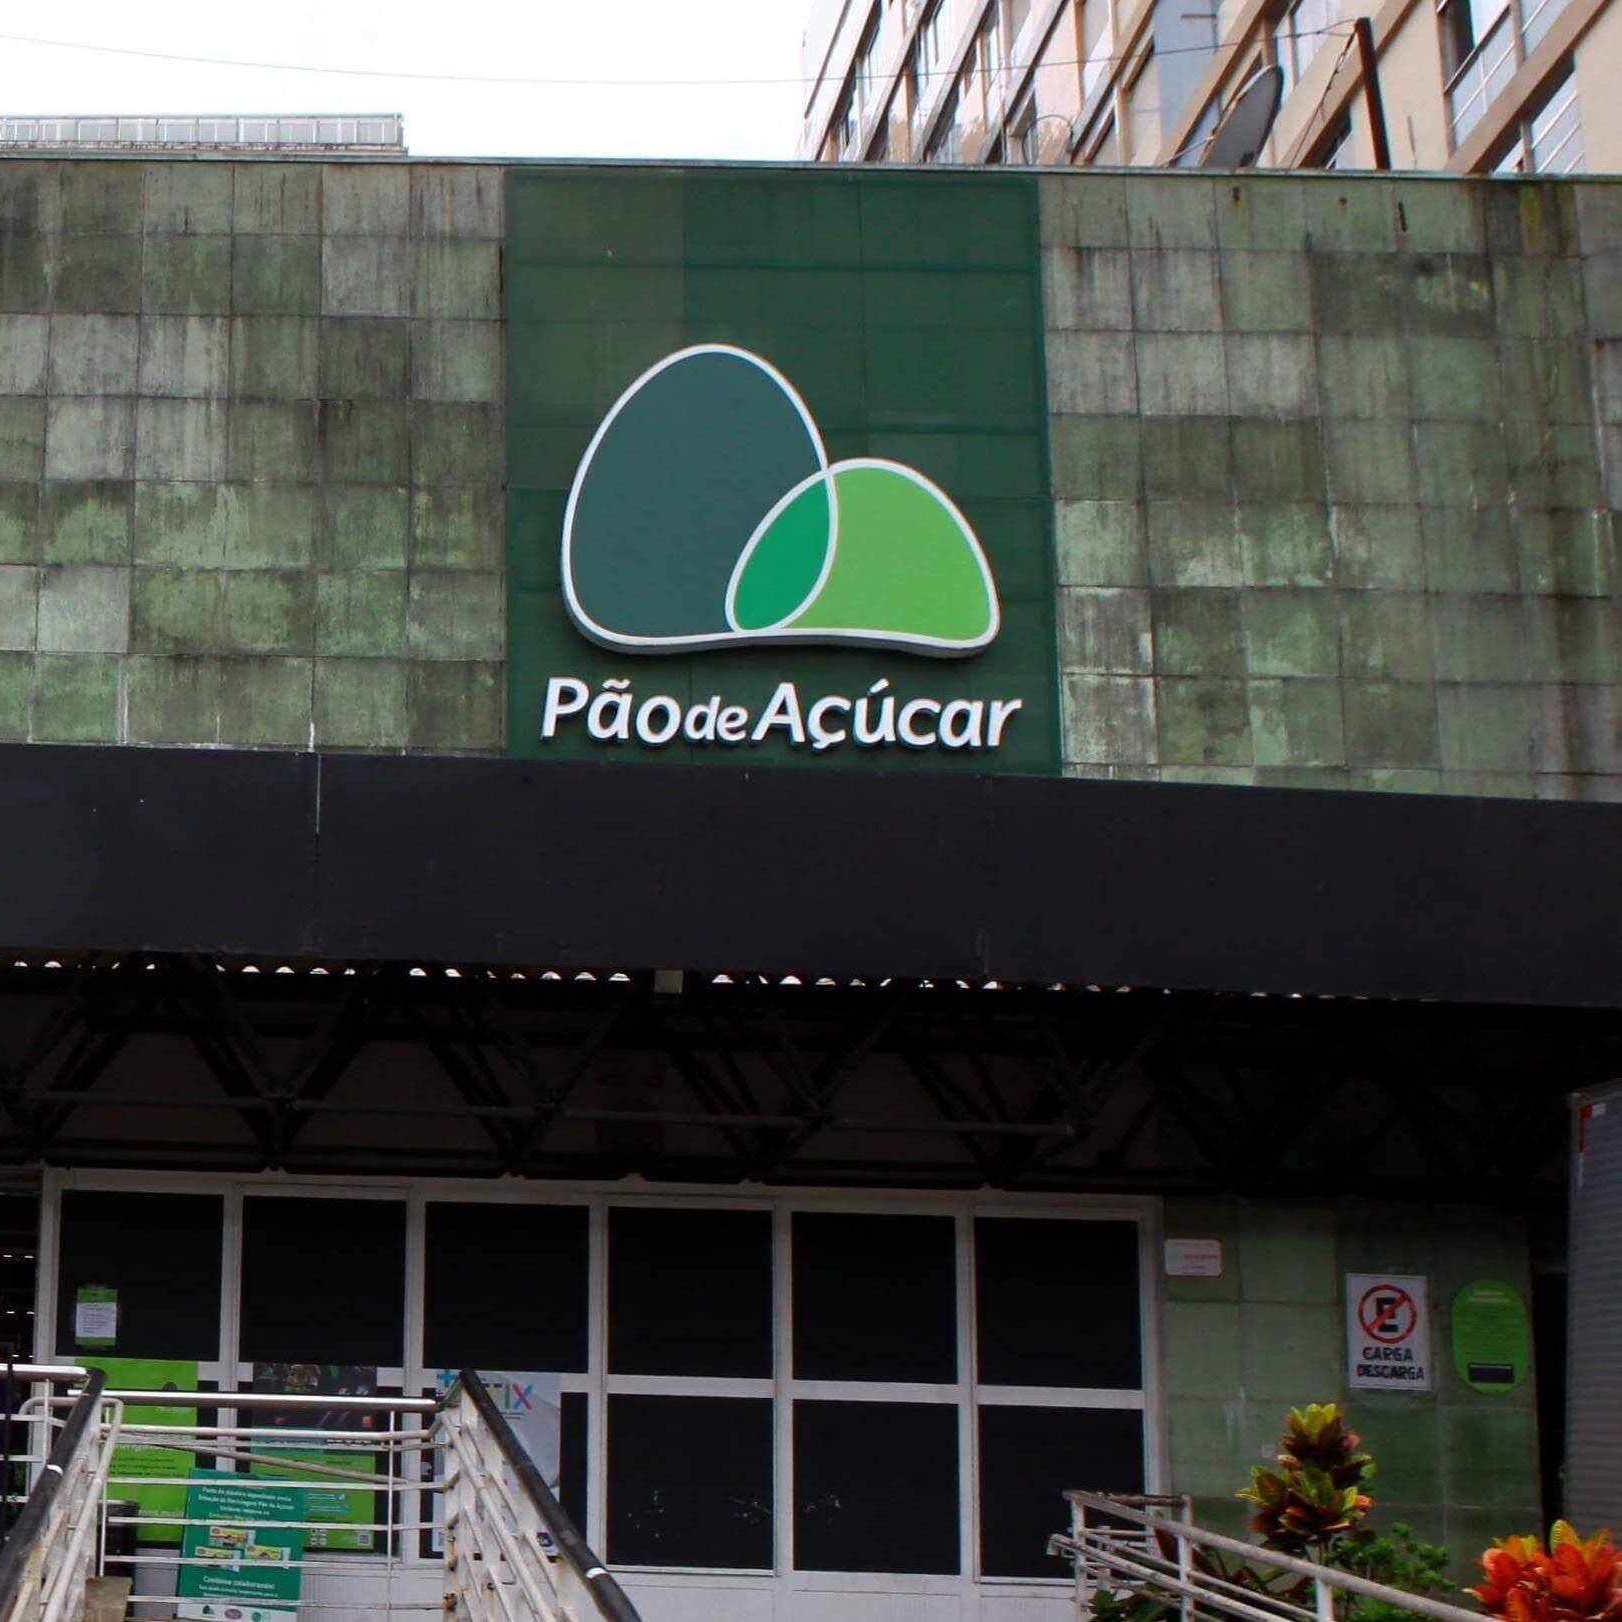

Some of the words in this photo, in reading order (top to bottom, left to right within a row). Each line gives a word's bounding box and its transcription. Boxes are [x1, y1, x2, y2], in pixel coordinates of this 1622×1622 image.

[540, 677, 682, 745] Pão
[684, 696, 747, 742] de
[751, 678, 1022, 749] Açúcar
[1363, 1347, 1414, 1362] CARGA
[1356, 1364, 1425, 1381] DESCARGA
